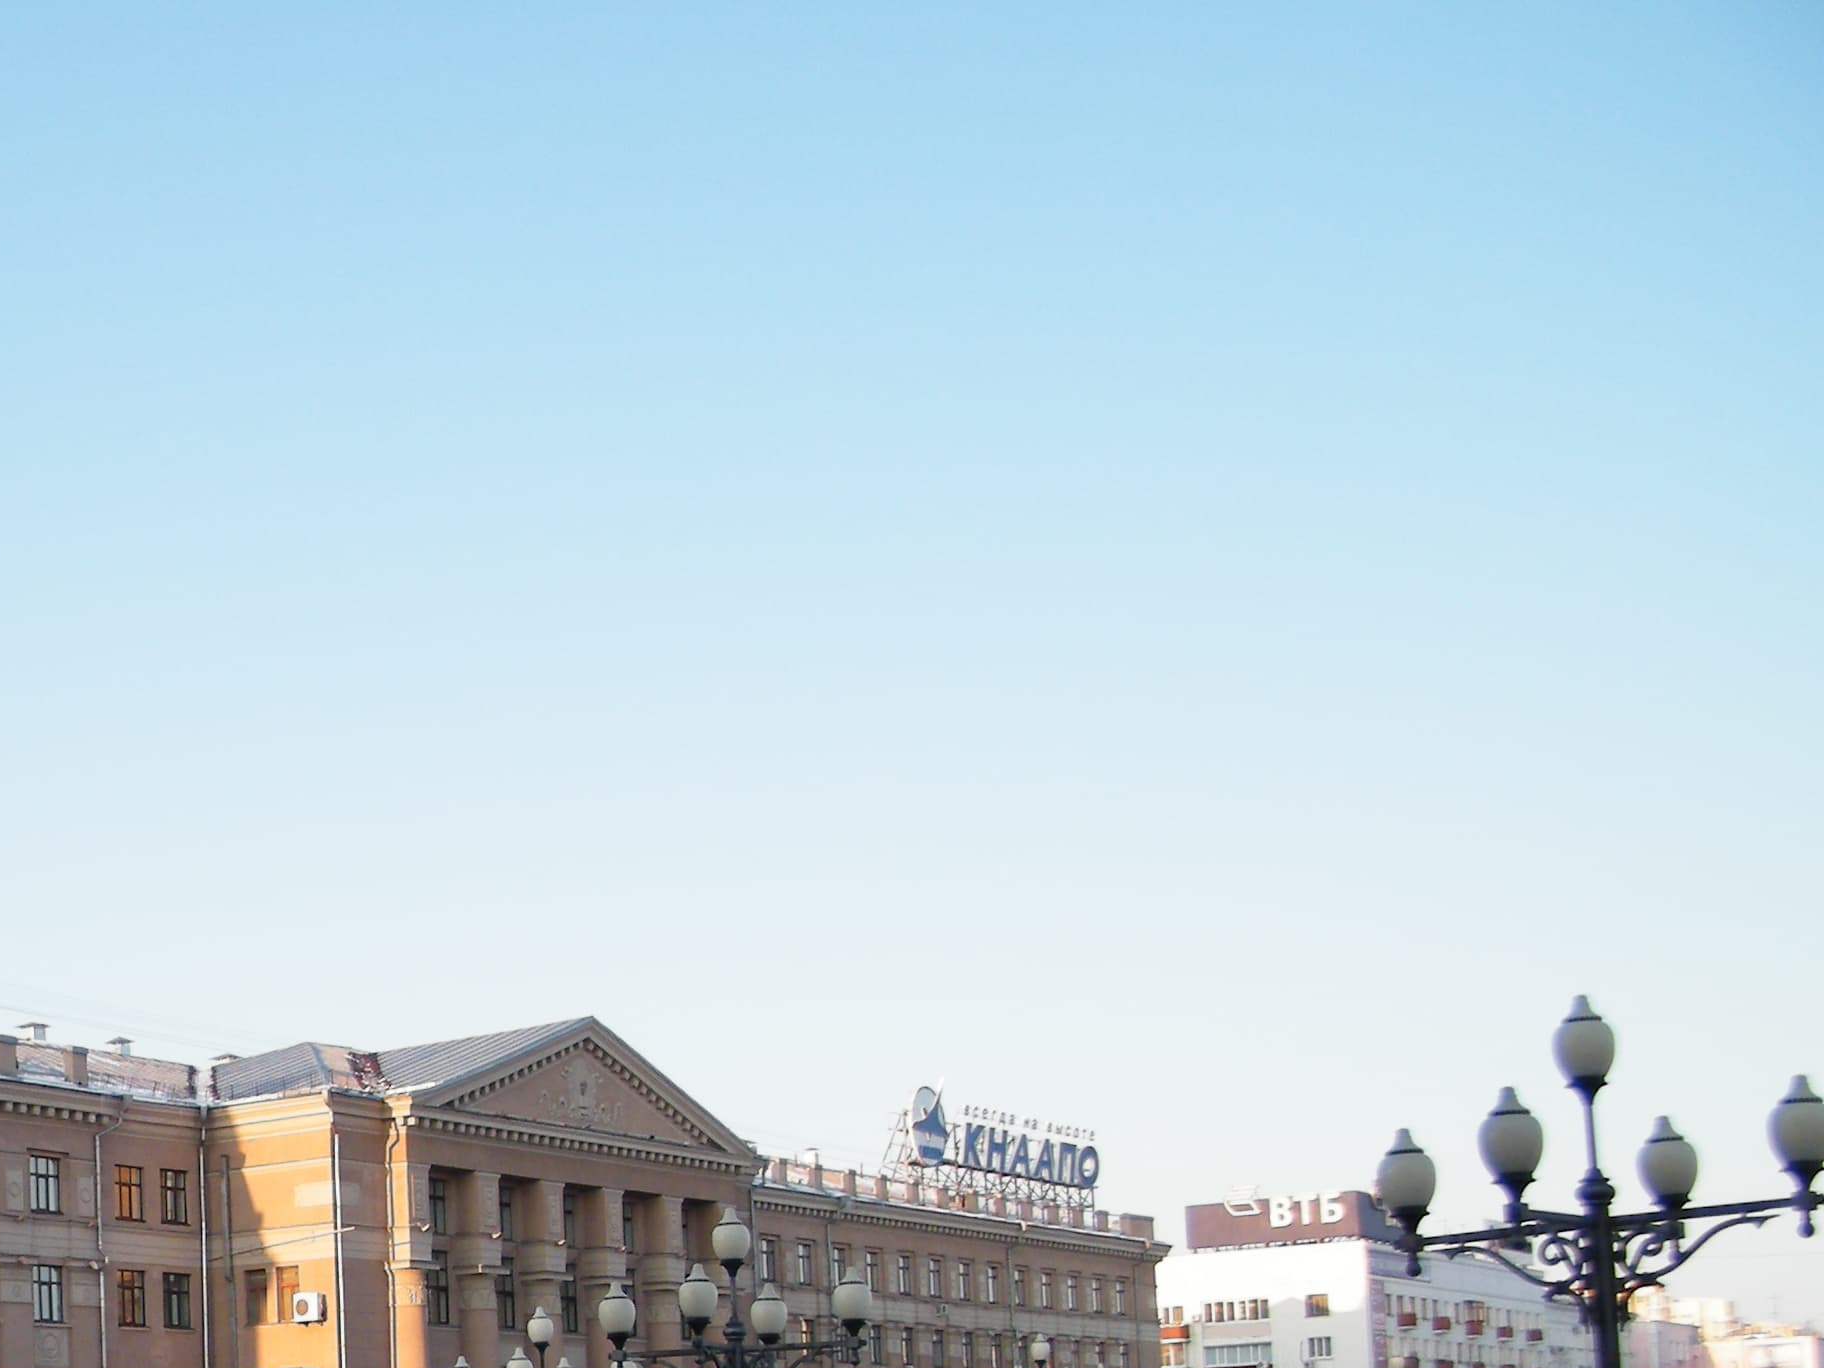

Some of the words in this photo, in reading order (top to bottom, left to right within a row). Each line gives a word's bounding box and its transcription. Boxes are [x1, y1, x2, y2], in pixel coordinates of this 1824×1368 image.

[964, 1105, 1015, 1125] всегда
[1023, 1118, 1038, 1130] на
[1047, 1122, 1095, 1141] высоте
[962, 1122, 1100, 1188] КНААПО
[1268, 1191, 1344, 1229] ВТБ
